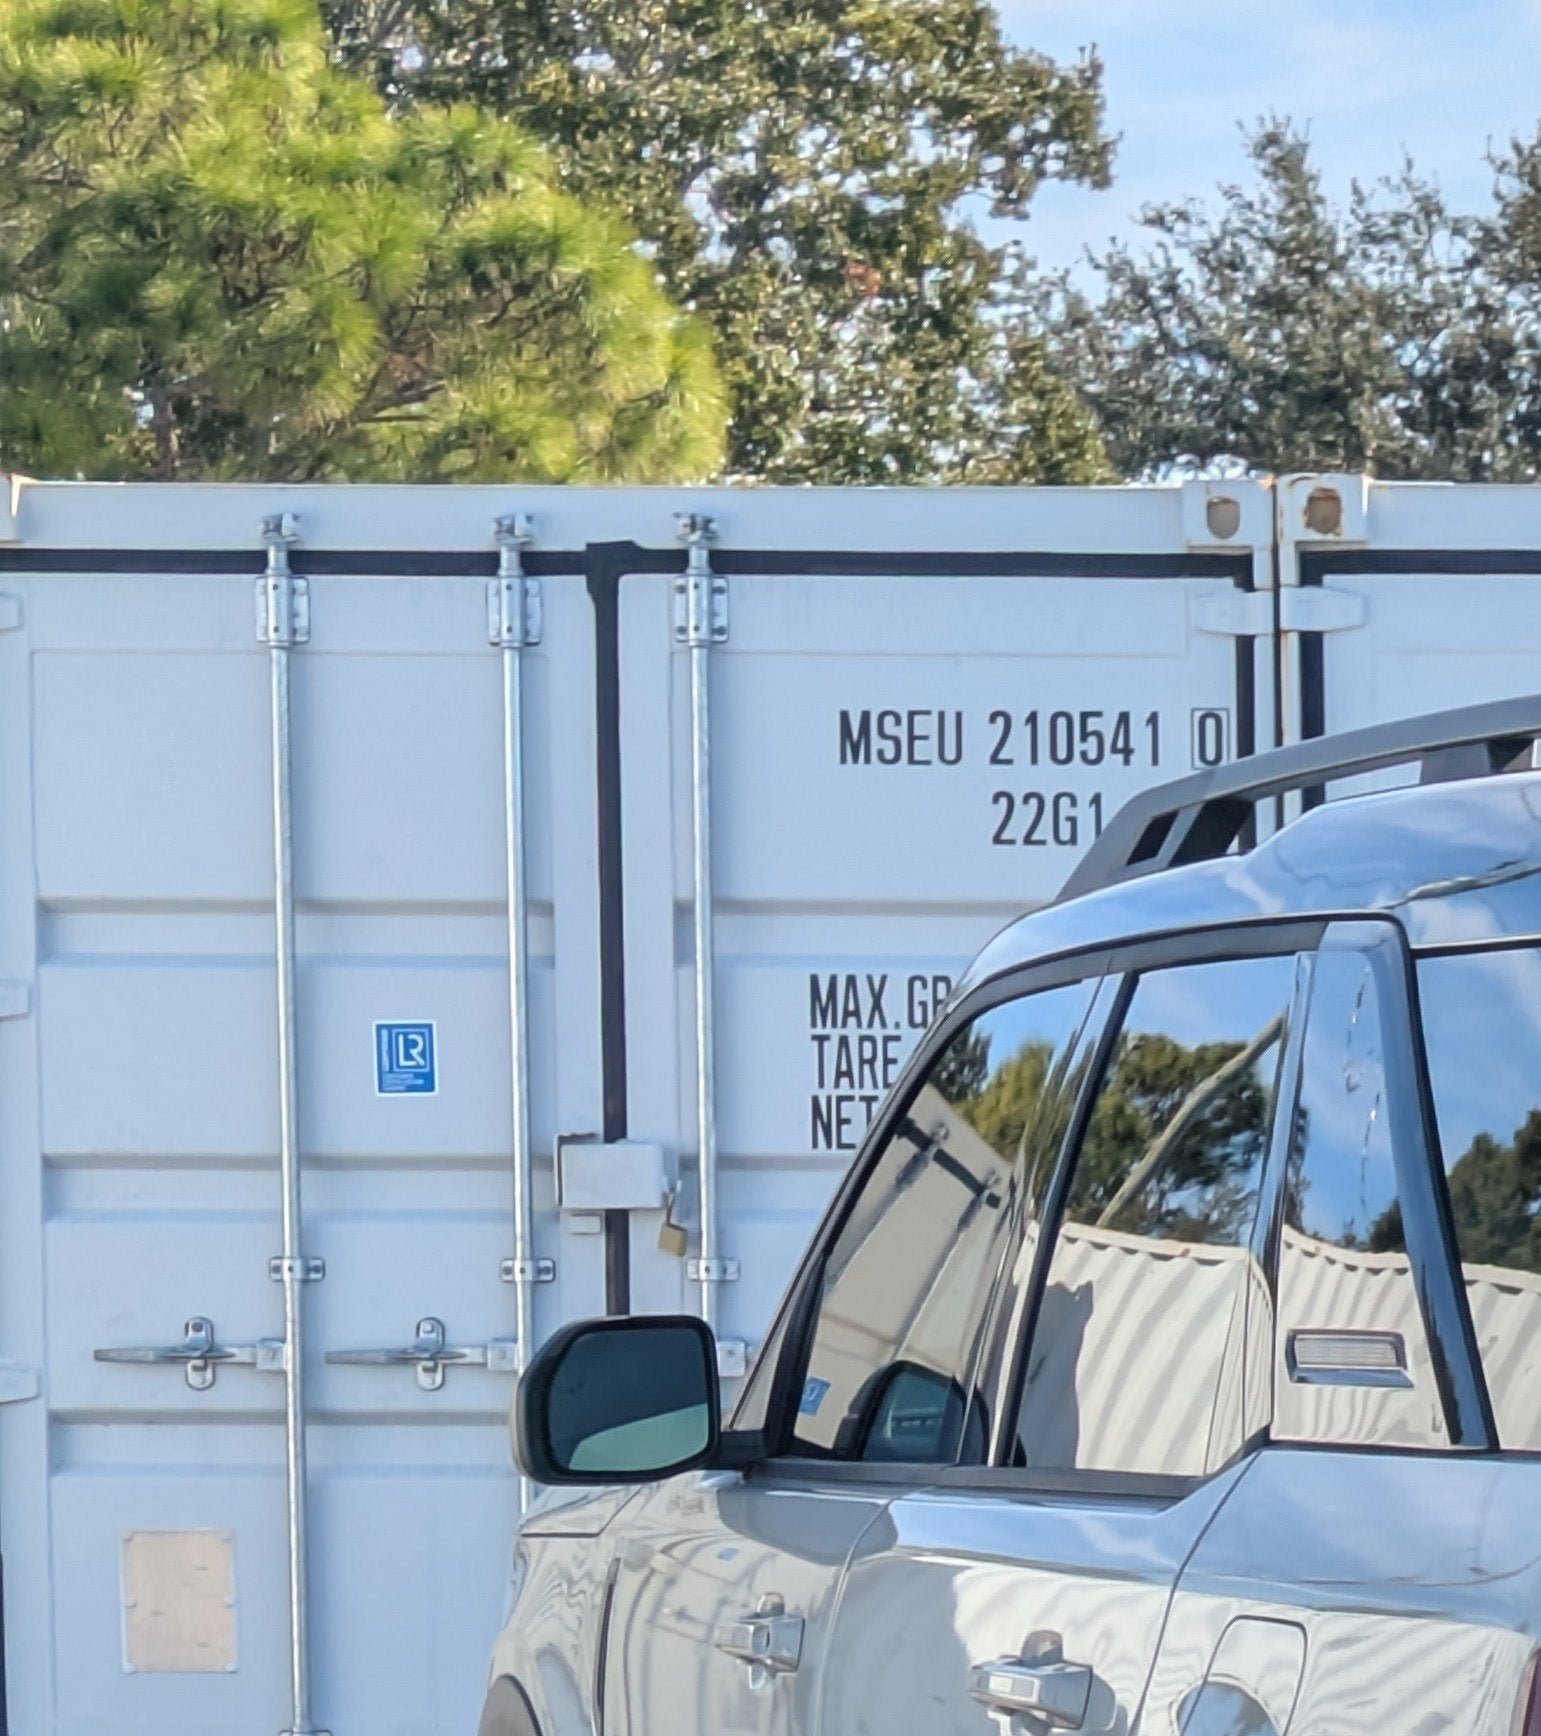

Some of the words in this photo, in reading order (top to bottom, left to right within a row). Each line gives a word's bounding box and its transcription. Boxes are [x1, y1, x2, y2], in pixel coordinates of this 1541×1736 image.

[838, 709, 963, 766] MSEU
[988, 710, 1160, 767] 210541
[1199, 710, 1224, 768] 0
[991, 791, 1104, 846] 22G1
[398, 1032, 426, 1067] LR
[811, 1034, 902, 1089] TARE
[810, 1095, 880, 1150] NET
